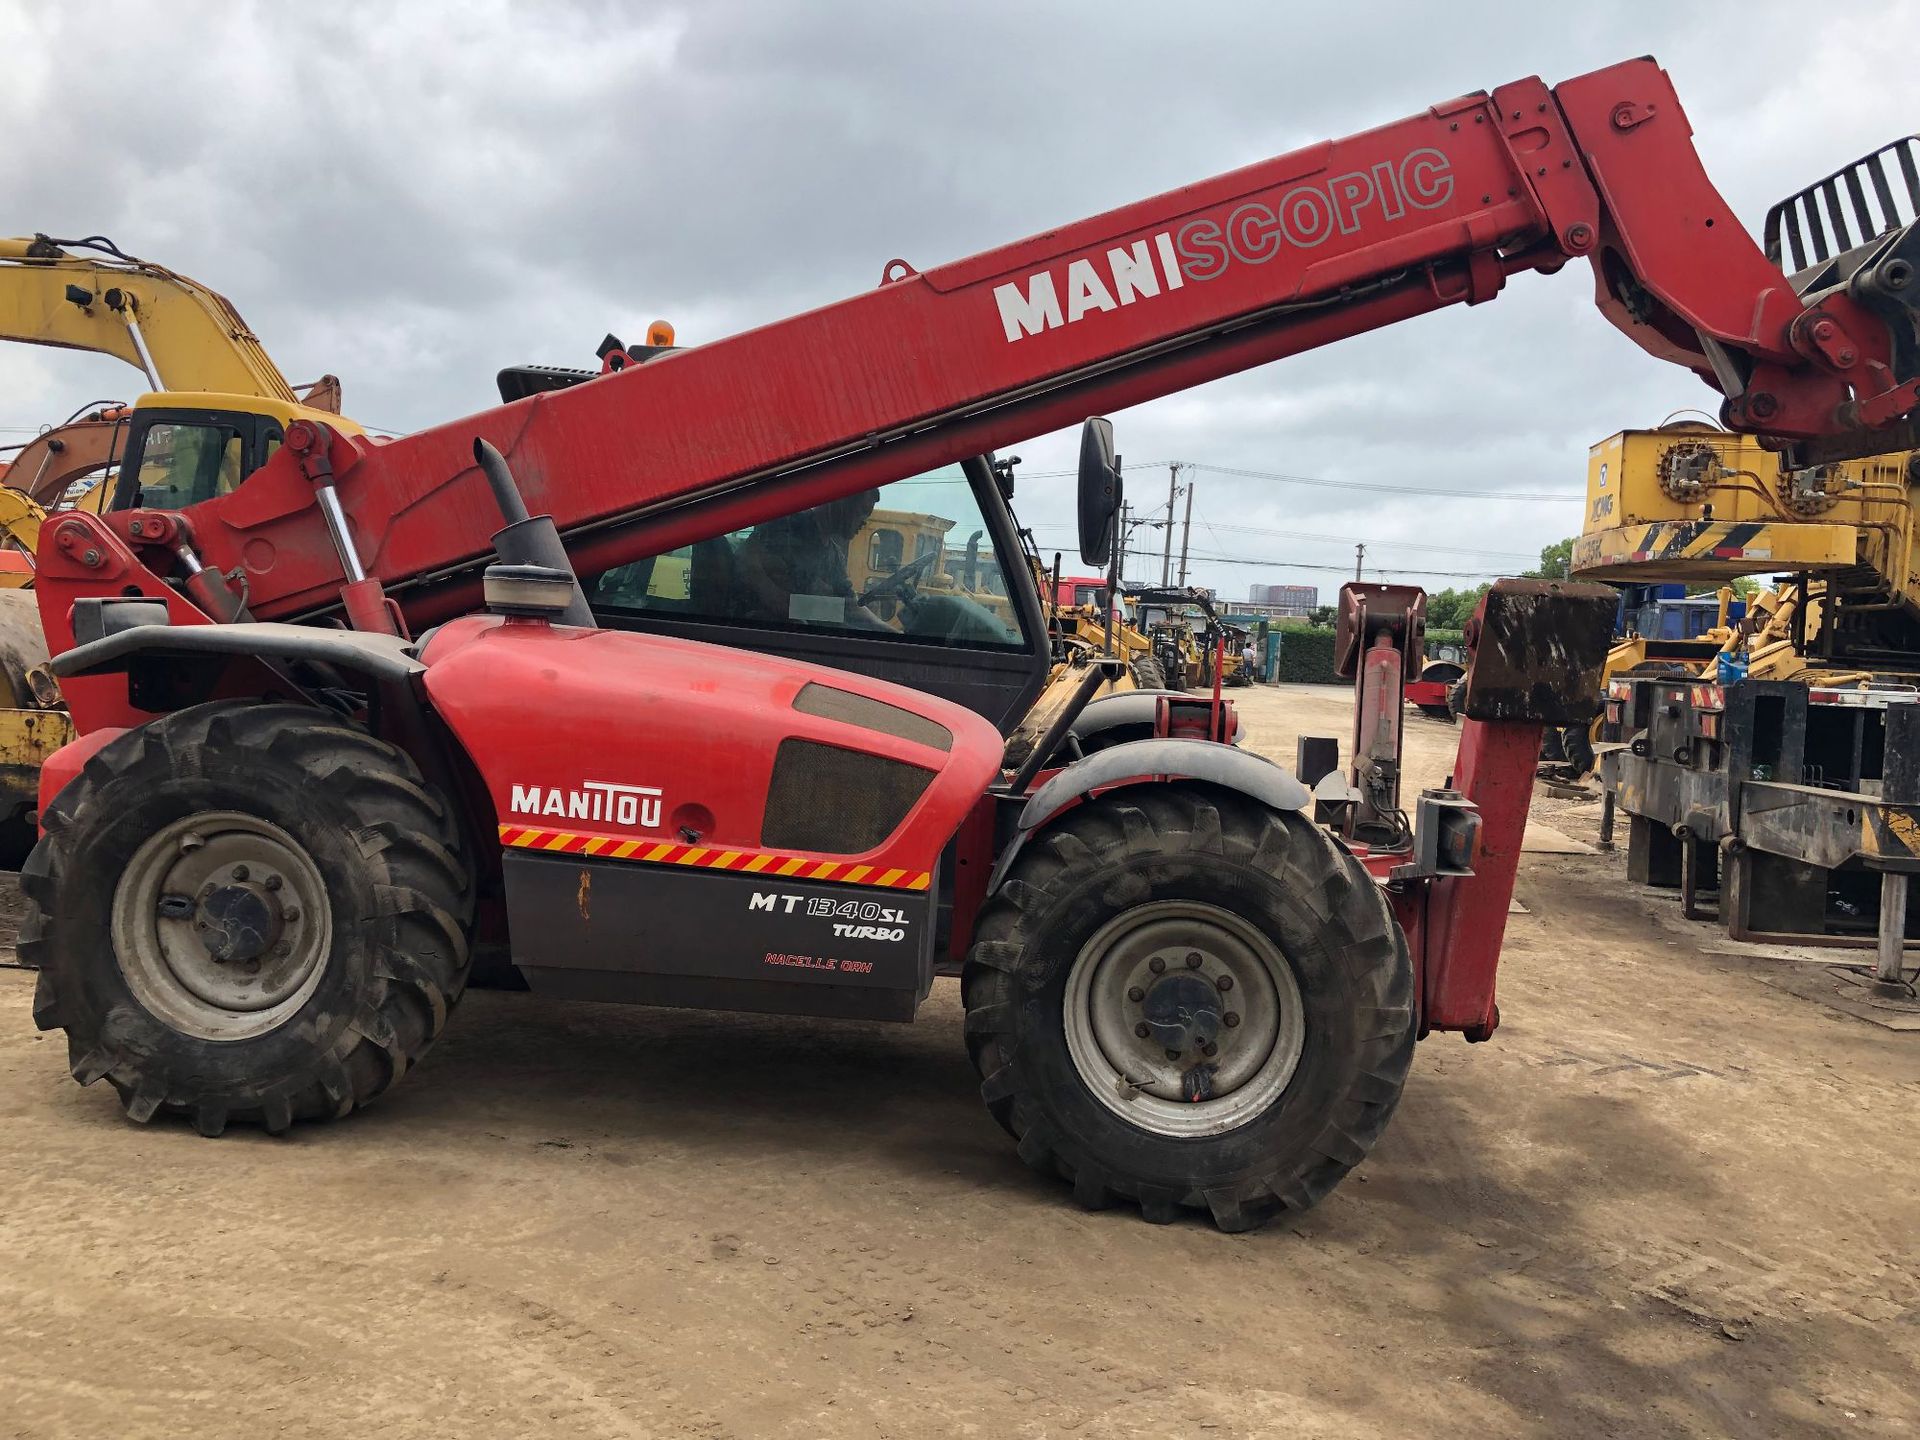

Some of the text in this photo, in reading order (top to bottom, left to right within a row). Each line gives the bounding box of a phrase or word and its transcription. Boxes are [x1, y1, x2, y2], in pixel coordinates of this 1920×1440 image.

[993, 148, 1454, 343] MANISCOPIC
[511, 780, 662, 827] MANITOU
[833, 923, 905, 942] TURBO
[764, 952, 837, 970] NACELLE
